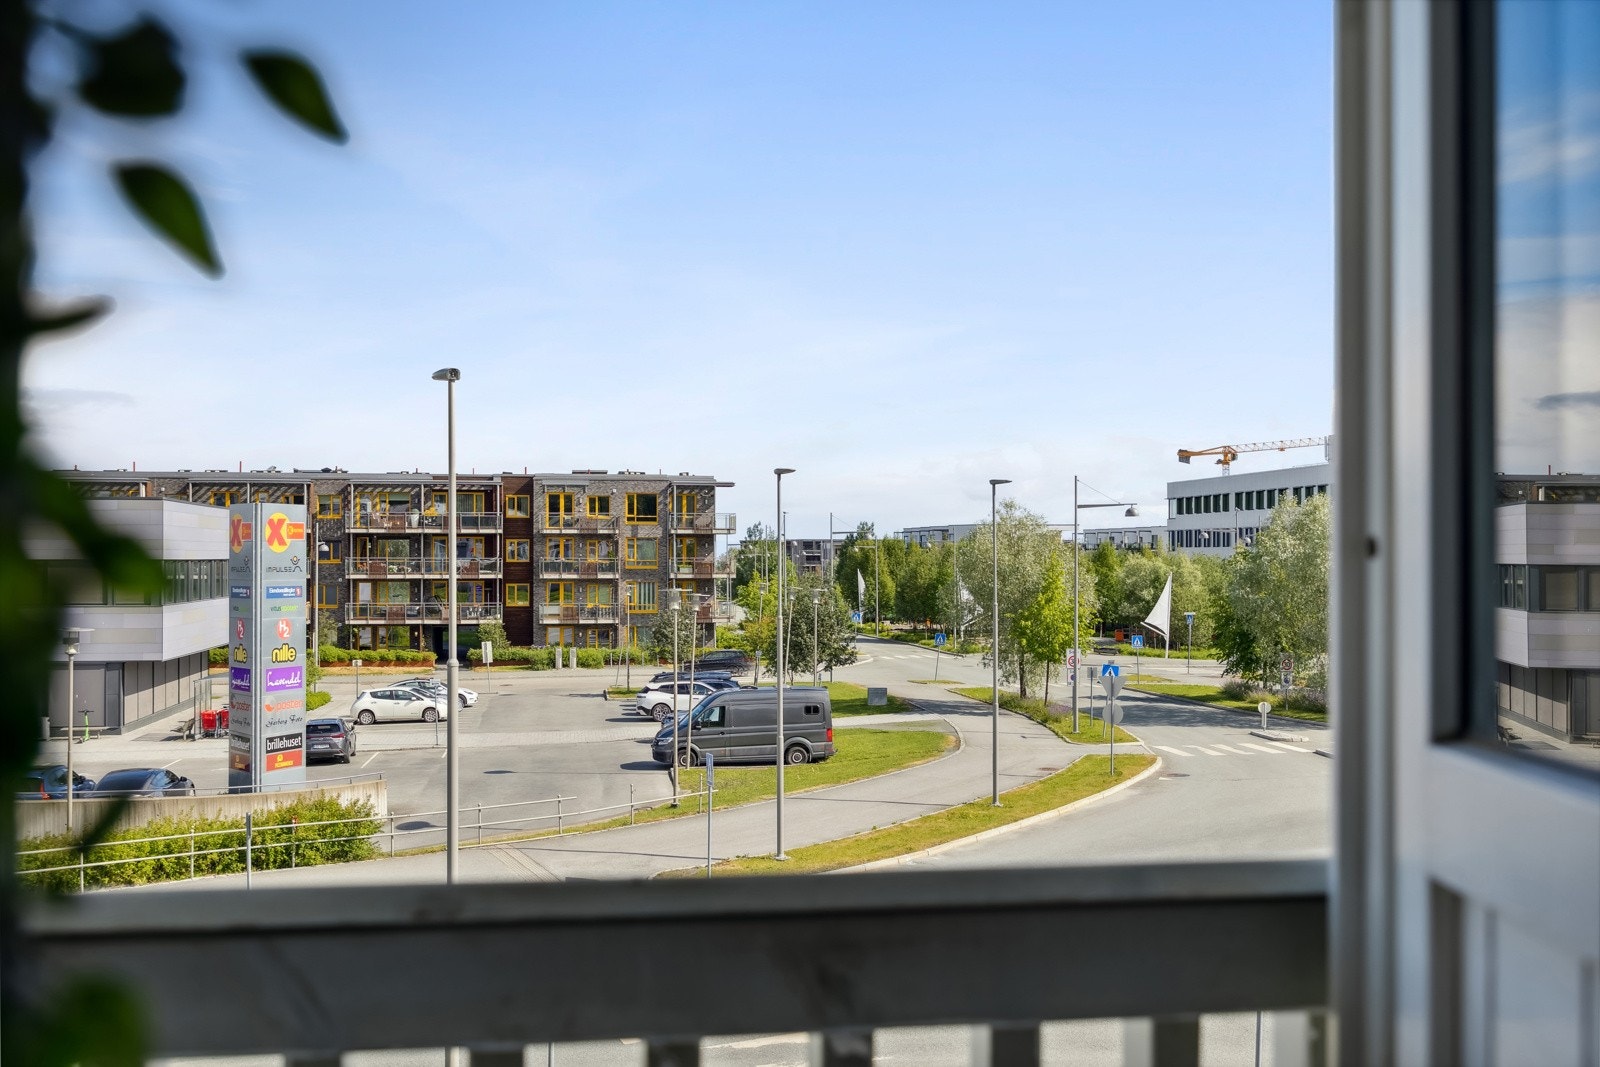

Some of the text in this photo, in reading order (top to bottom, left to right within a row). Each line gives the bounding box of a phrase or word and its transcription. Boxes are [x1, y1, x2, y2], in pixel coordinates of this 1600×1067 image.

[267, 518, 287, 547] X
[272, 643, 296, 663] nille
[267, 736, 302, 751] brillehuset
